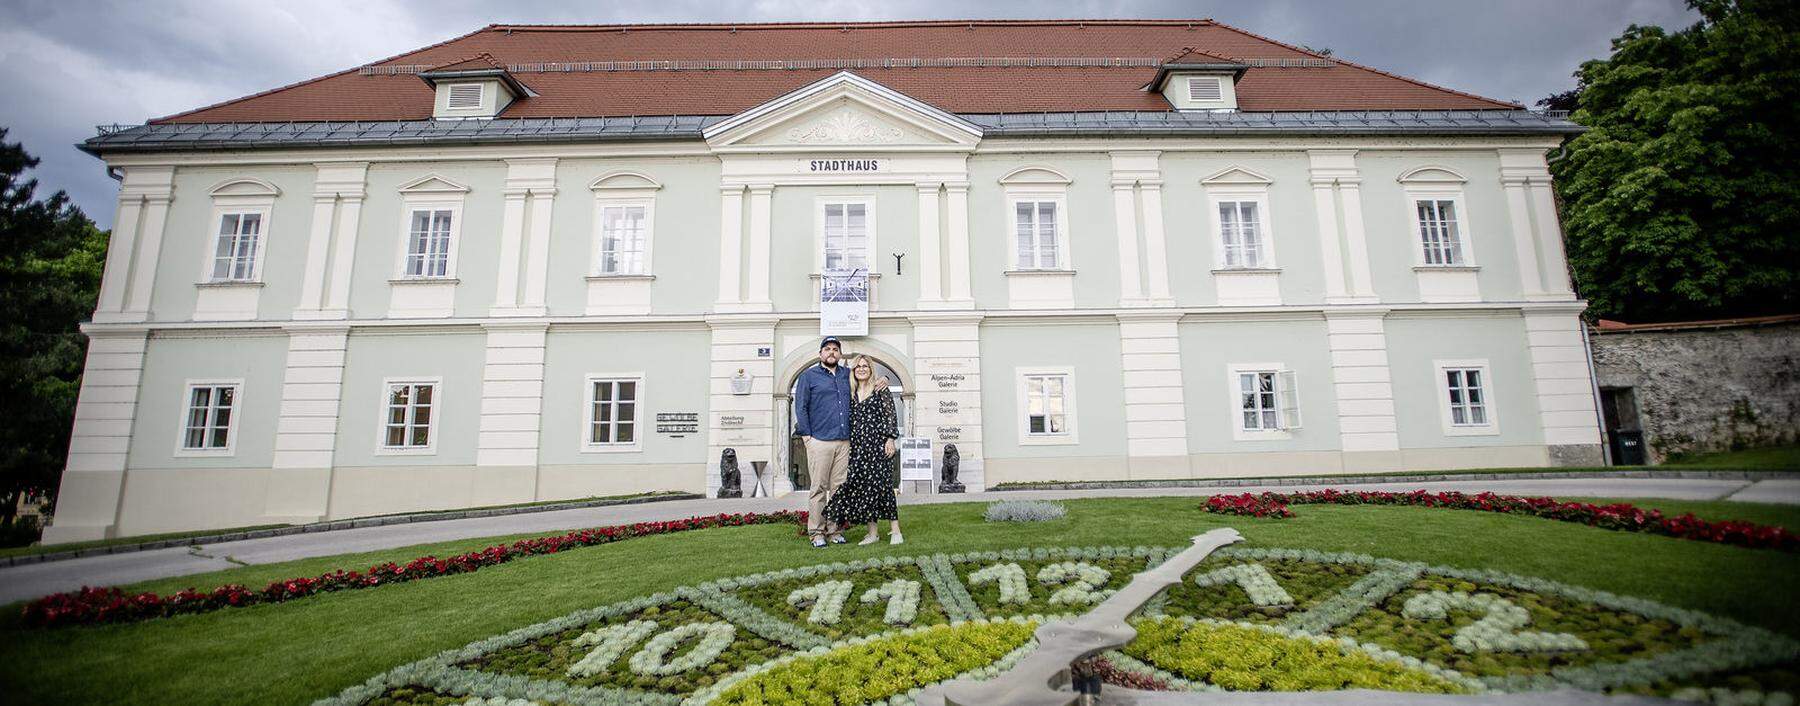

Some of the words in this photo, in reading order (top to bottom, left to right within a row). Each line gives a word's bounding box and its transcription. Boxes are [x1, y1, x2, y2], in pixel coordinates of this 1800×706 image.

[810, 160, 878, 171] STADTHAUS
[931, 374, 965, 382] Alpen-Adria
[788, 579, 922, 626] 11
[968, 562, 1118, 605] 12
[1195, 562, 1295, 606] 1
[1401, 590, 1590, 653] 2
[567, 620, 735, 677] 10
